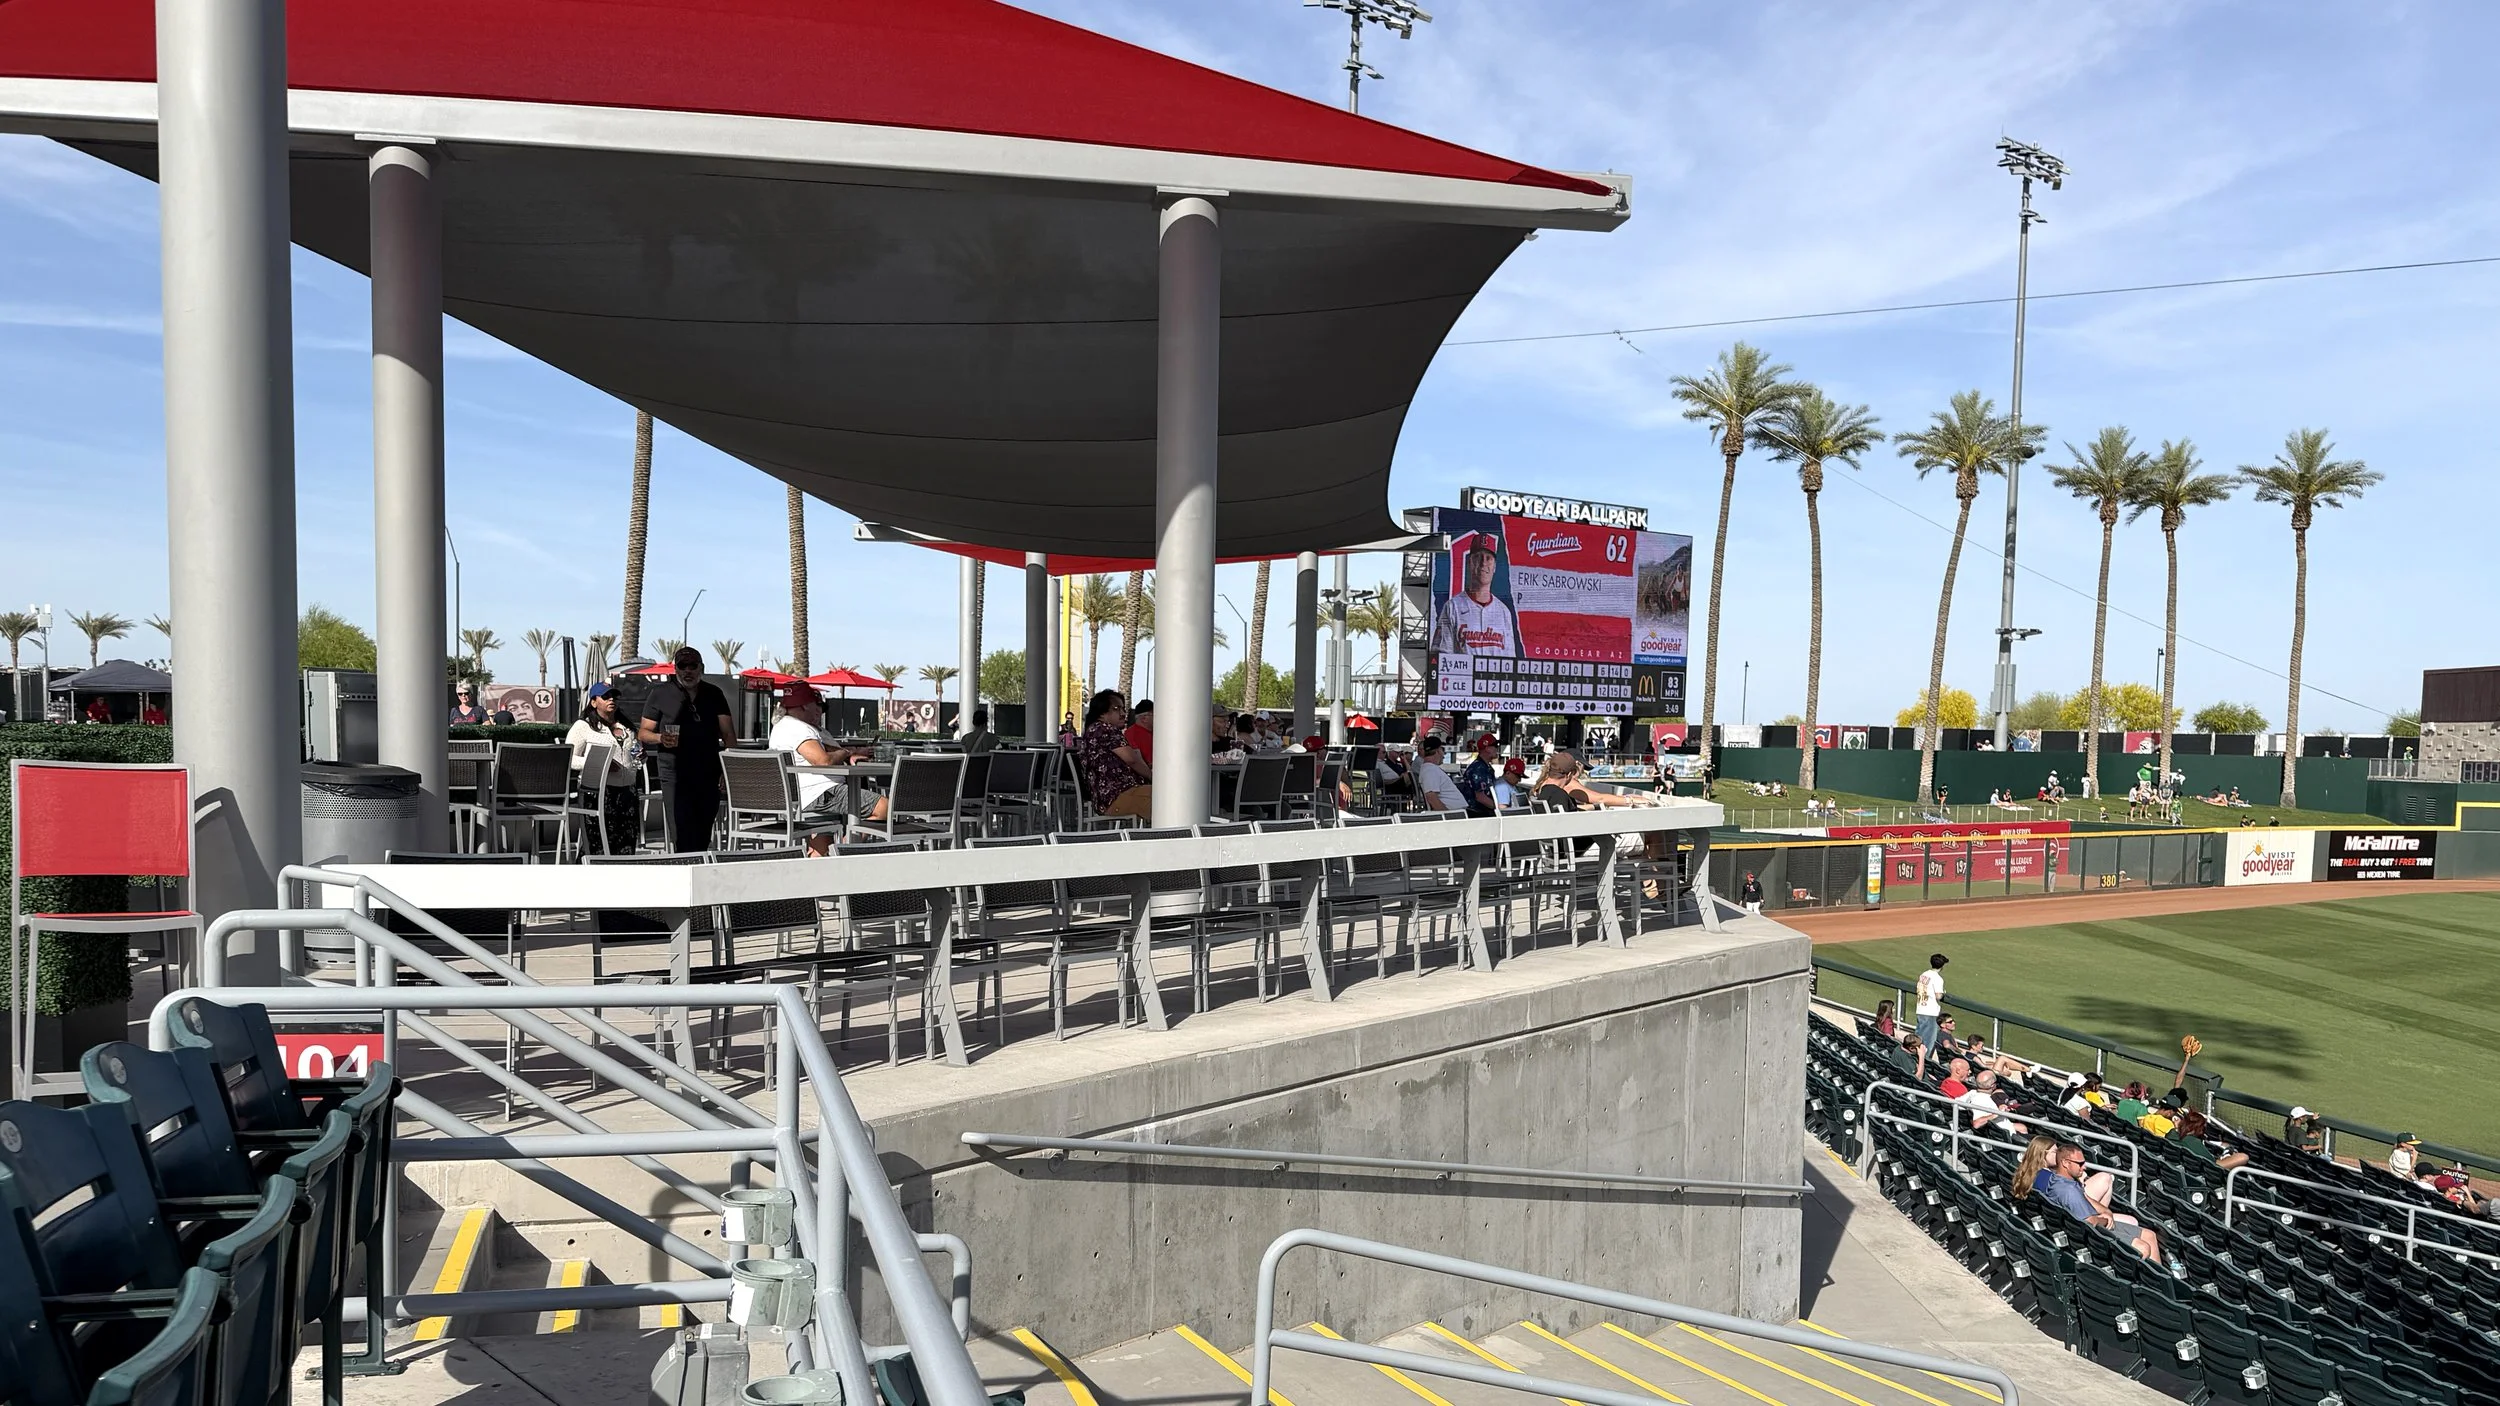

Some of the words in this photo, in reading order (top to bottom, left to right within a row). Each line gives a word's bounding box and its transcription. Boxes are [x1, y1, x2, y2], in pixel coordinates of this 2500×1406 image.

[1472, 492, 1568, 518] GOODYEAR
[1570, 505, 1648, 527] BALLPARK
[1528, 532, 1582, 557] Guardians
[1606, 534, 1627, 562] 62
[1518, 572, 1538, 587] ERIK
[1542, 574, 1602, 591] SABROWSKI
[1517, 592, 1522, 604] P
[1535, 647, 1600, 657] GOODYEAR
[1641, 640, 1681, 652] goodyear
[1454, 661, 1468, 669] ATH
[1432, 670, 1436, 679] 9
[1453, 682, 1466, 690] CLE
[1668, 677, 1679, 688] 83
[538, 694, 550, 704] 14
[1440, 698, 1524, 711] goodyearbp.com
[1536, 701, 1542, 710] B
[1575, 702, 1580, 712] S
[1665, 705, 1679, 713] 3:49
[2016, 857, 2032, 865] LEAGUE
[2243, 852, 2294, 877] goodyear
[2330, 859, 2343, 867] THE
[1898, 862, 1913, 878] 1961
[1929, 861, 1942, 876] 1970
[2101, 875, 2116, 887] 380
[2442, 1170, 2468, 1179] CAUTION
